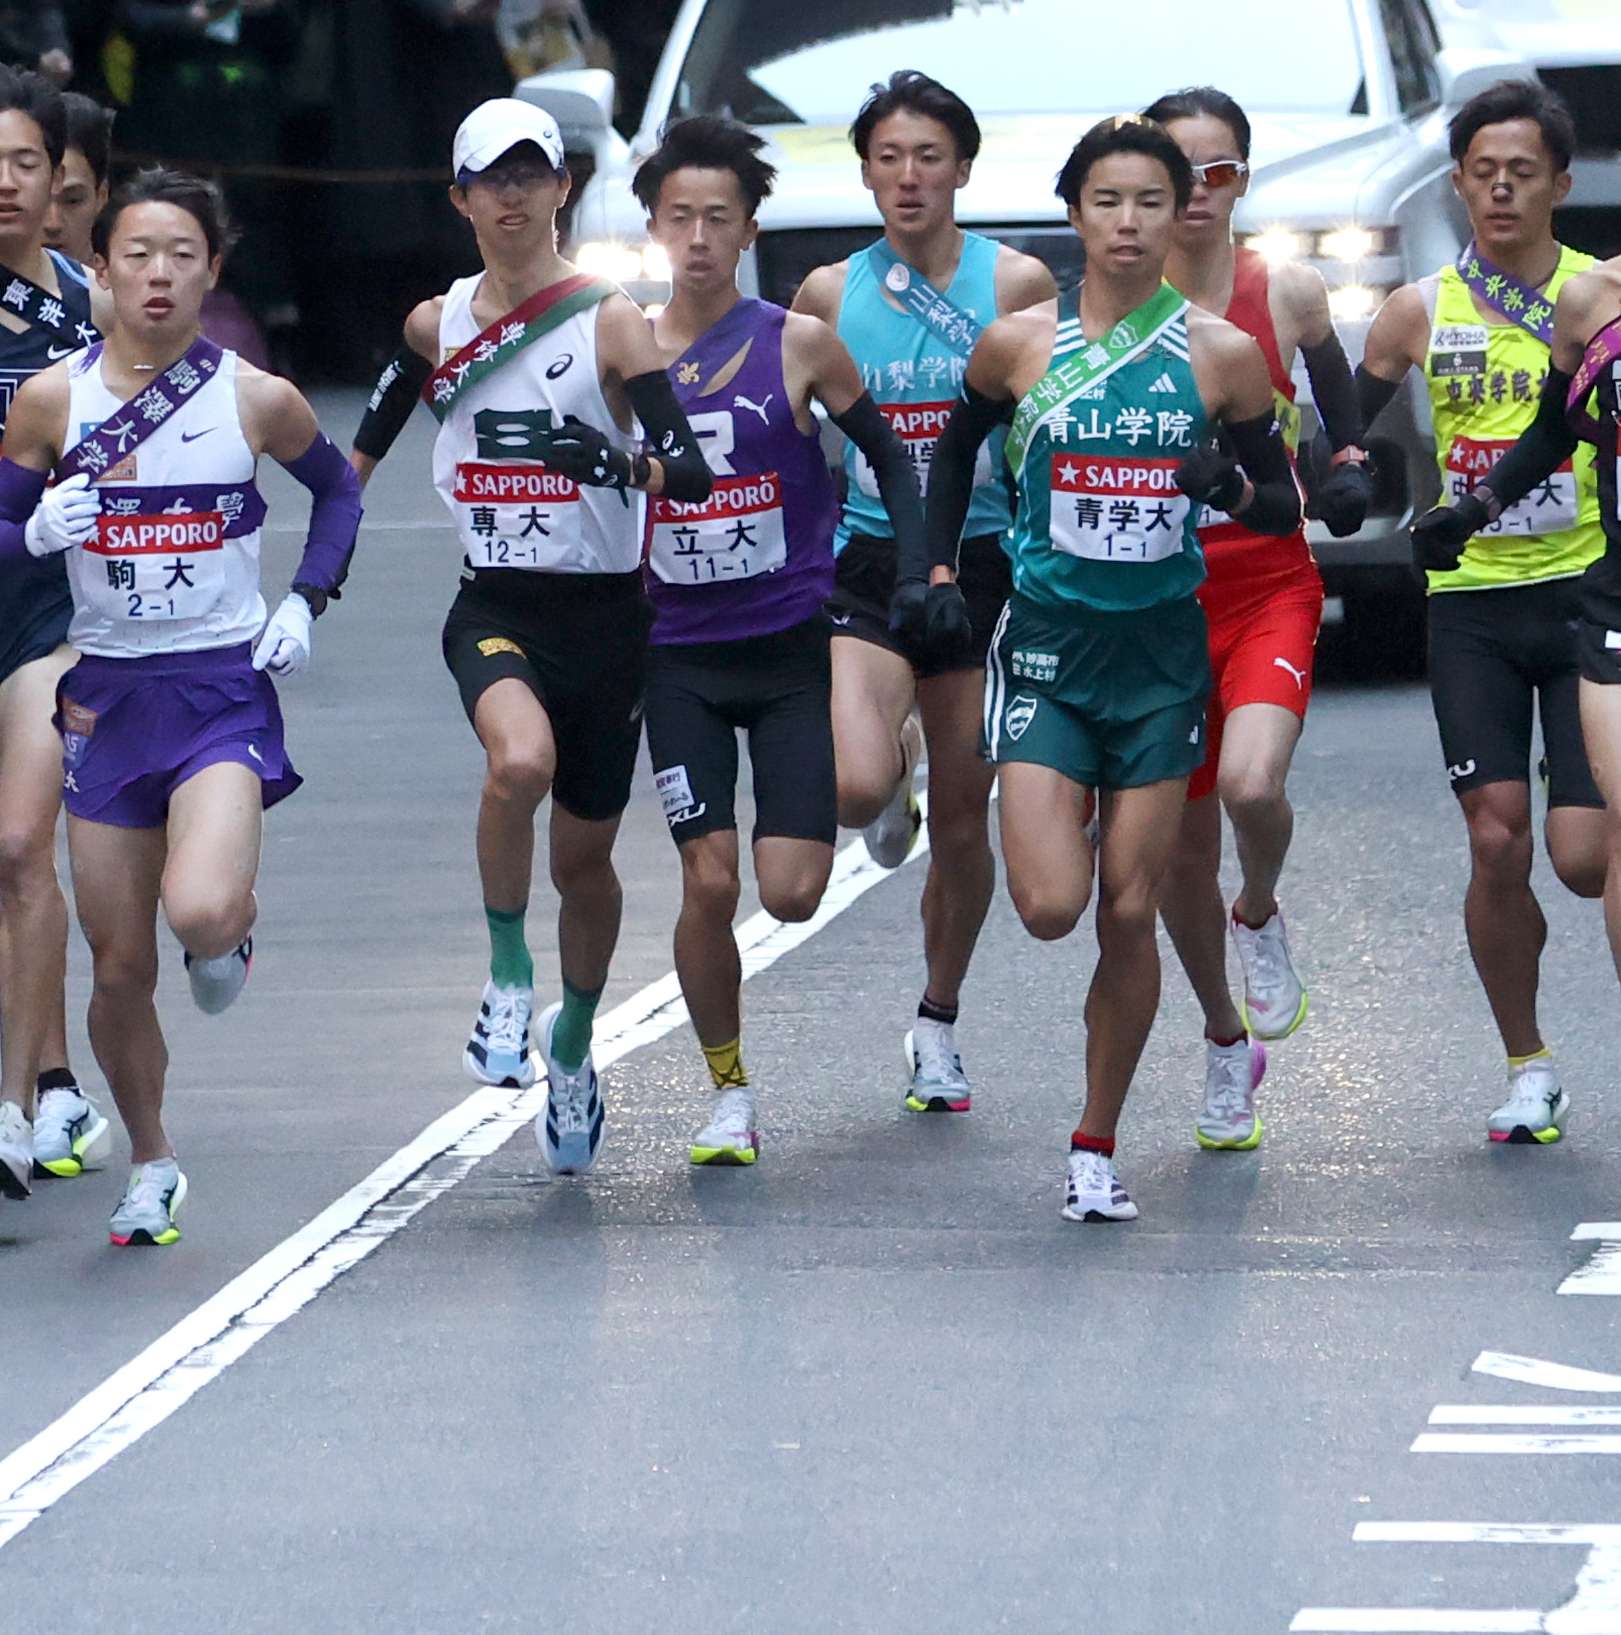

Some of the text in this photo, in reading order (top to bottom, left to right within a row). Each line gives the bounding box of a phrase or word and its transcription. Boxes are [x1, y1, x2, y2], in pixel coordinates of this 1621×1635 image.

[472, 473, 573, 496] SAPPORO
[1074, 497, 1173, 532] 青学大
[106, 520, 219, 548] SAPPORO
[1104, 534, 1147, 558] 1-1
[484, 540, 537, 564] 12-1
[689, 557, 749, 581] 11-1
[128, 594, 175, 617] 2-1
